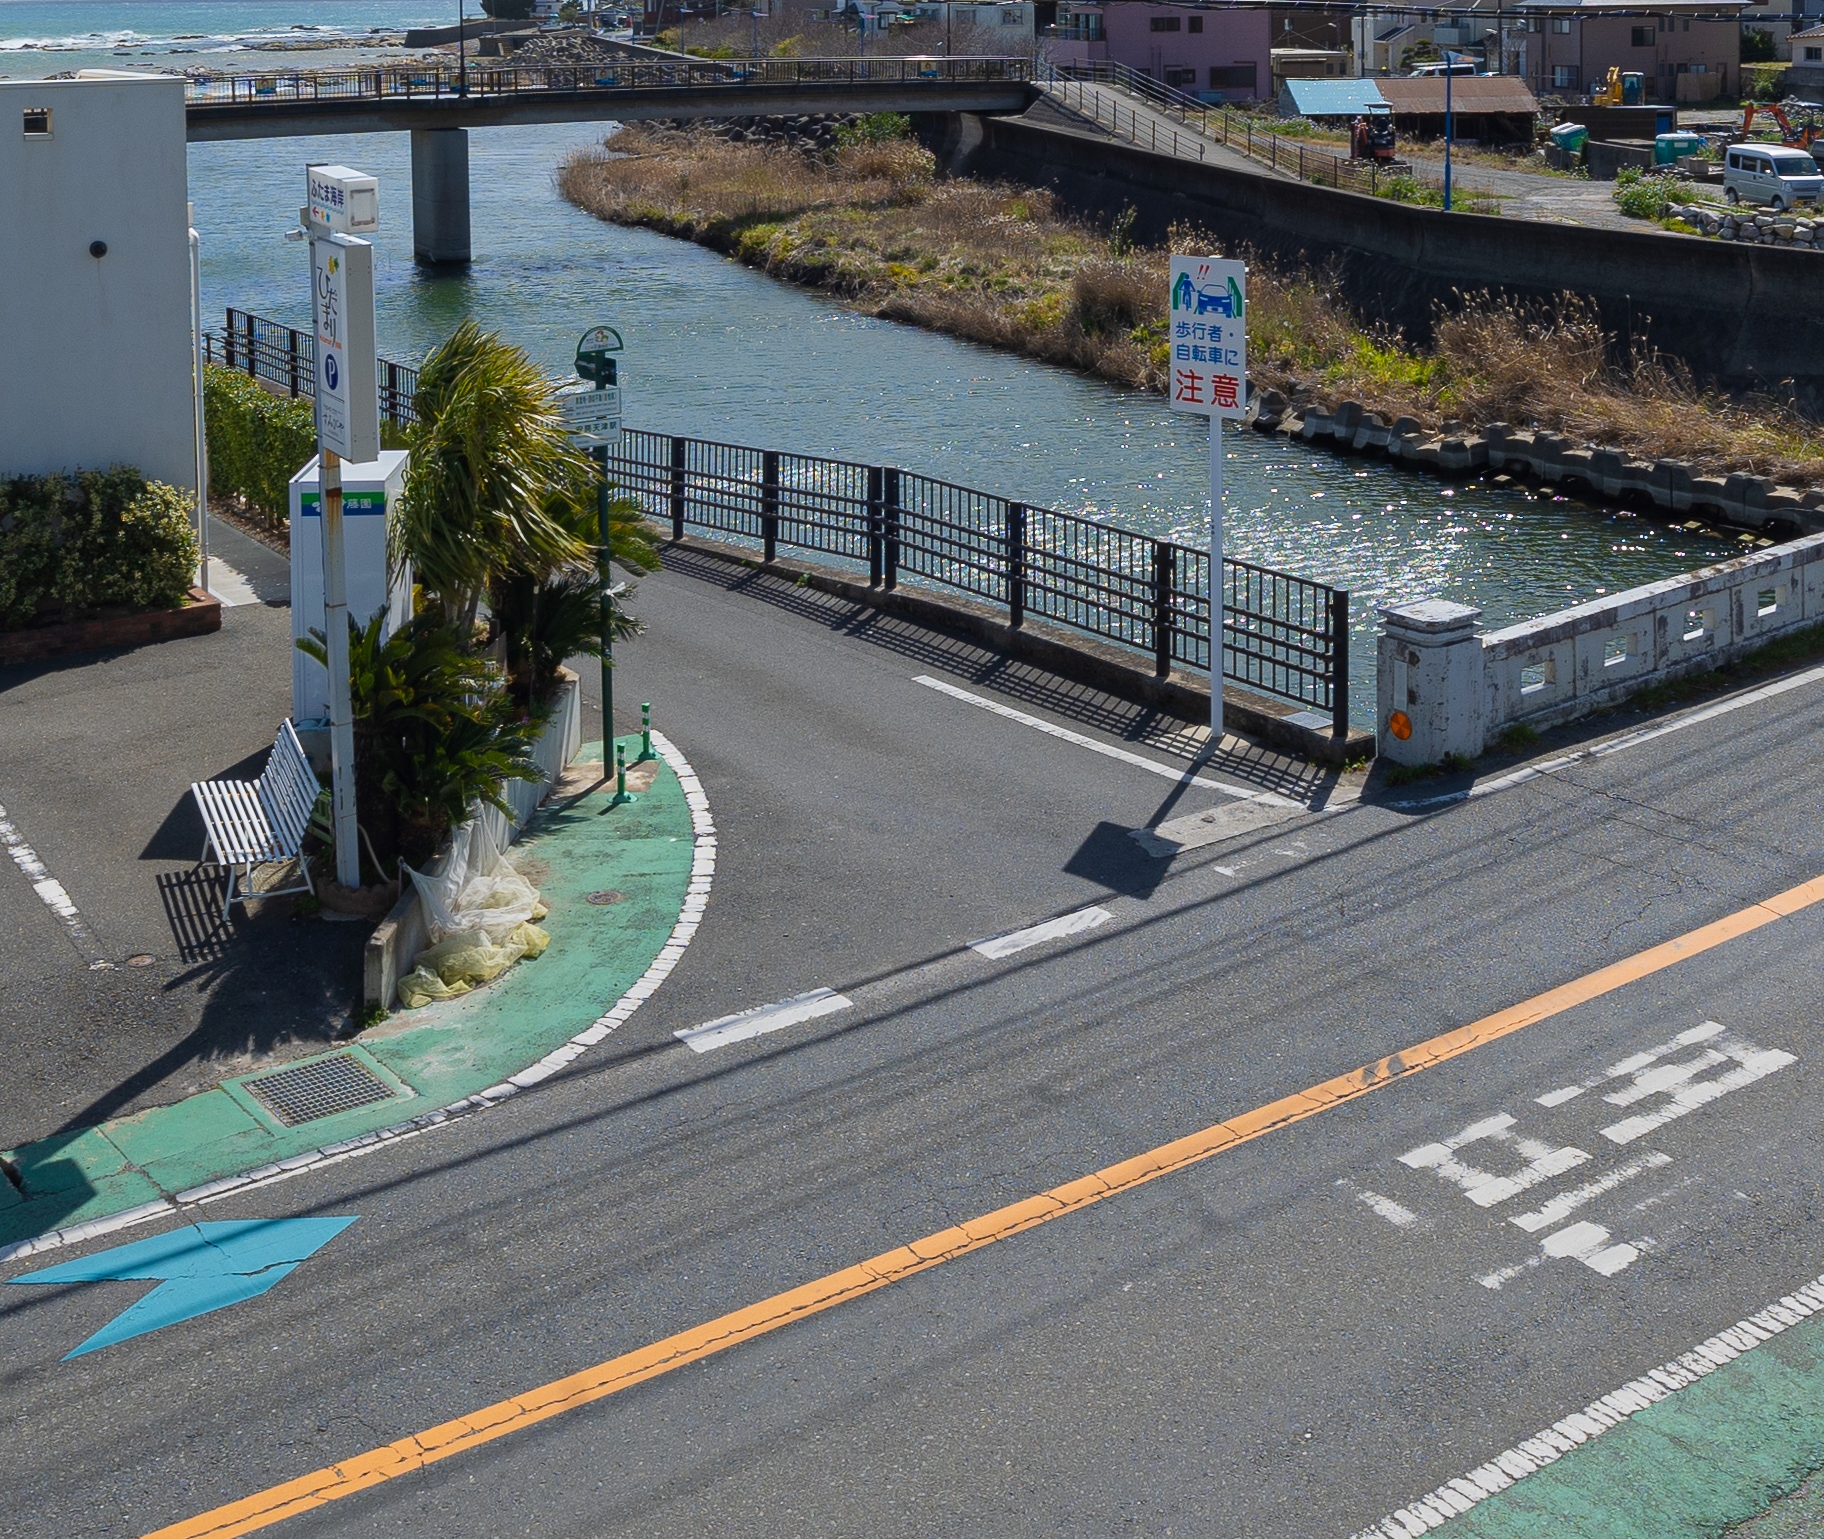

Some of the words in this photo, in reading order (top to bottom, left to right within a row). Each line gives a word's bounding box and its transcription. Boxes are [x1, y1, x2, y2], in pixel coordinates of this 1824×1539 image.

[311, 178, 345, 209] ふたま海岸
[316, 266, 339, 348] ひだまり
[1176, 343, 1239, 366] 自転車に
[1175, 368, 1240, 409] 注意
[342, 498, 372, 509] 藤園
